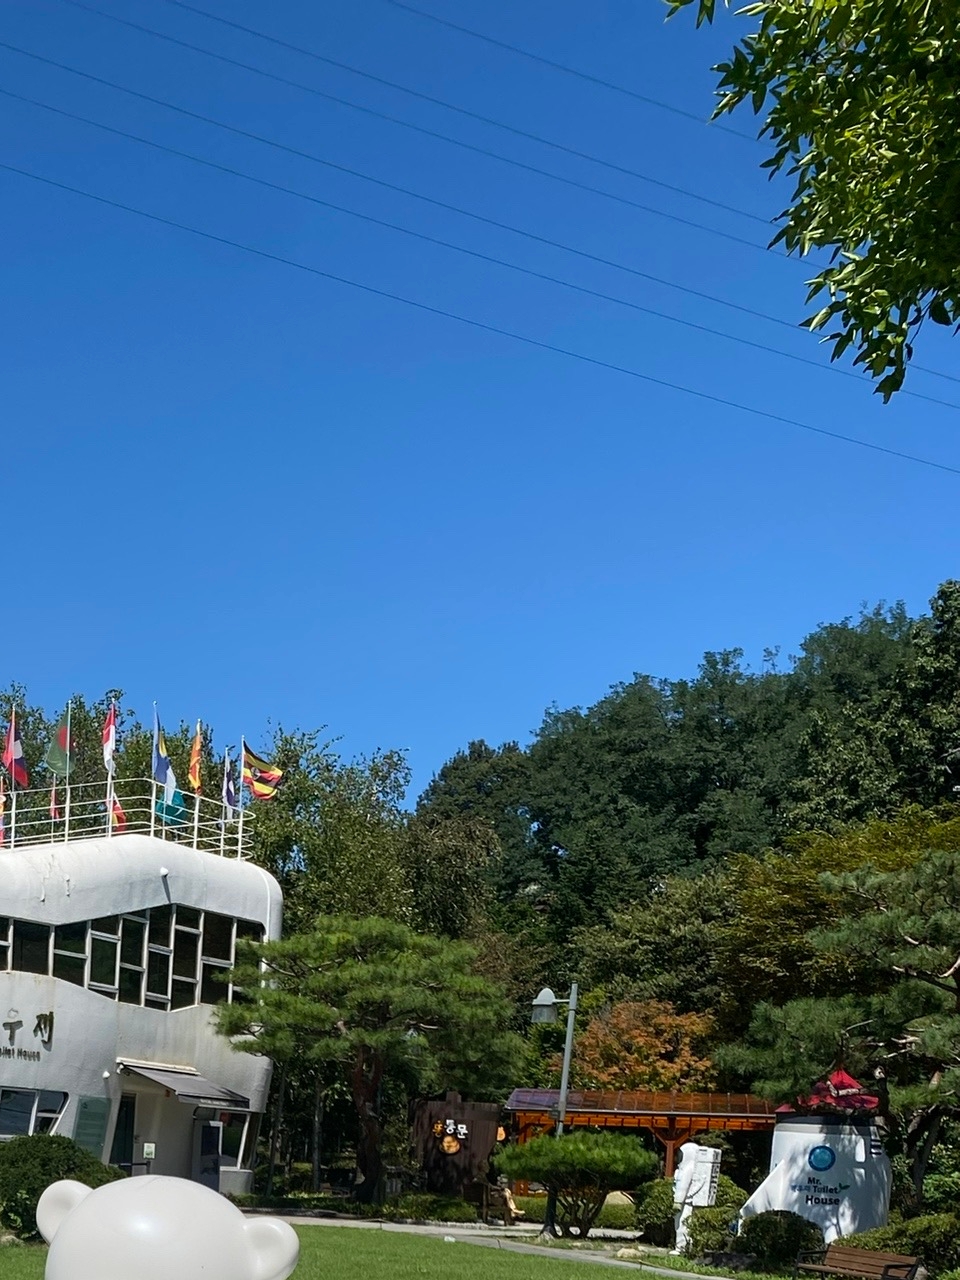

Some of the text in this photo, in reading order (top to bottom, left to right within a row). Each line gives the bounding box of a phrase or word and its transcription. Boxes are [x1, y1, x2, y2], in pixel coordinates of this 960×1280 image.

[17, 1048, 41, 1061] House
[807, 1177, 822, 1185] Mr.
[813, 1185, 839, 1194] Toilet
[805, 1195, 840, 1205] House
